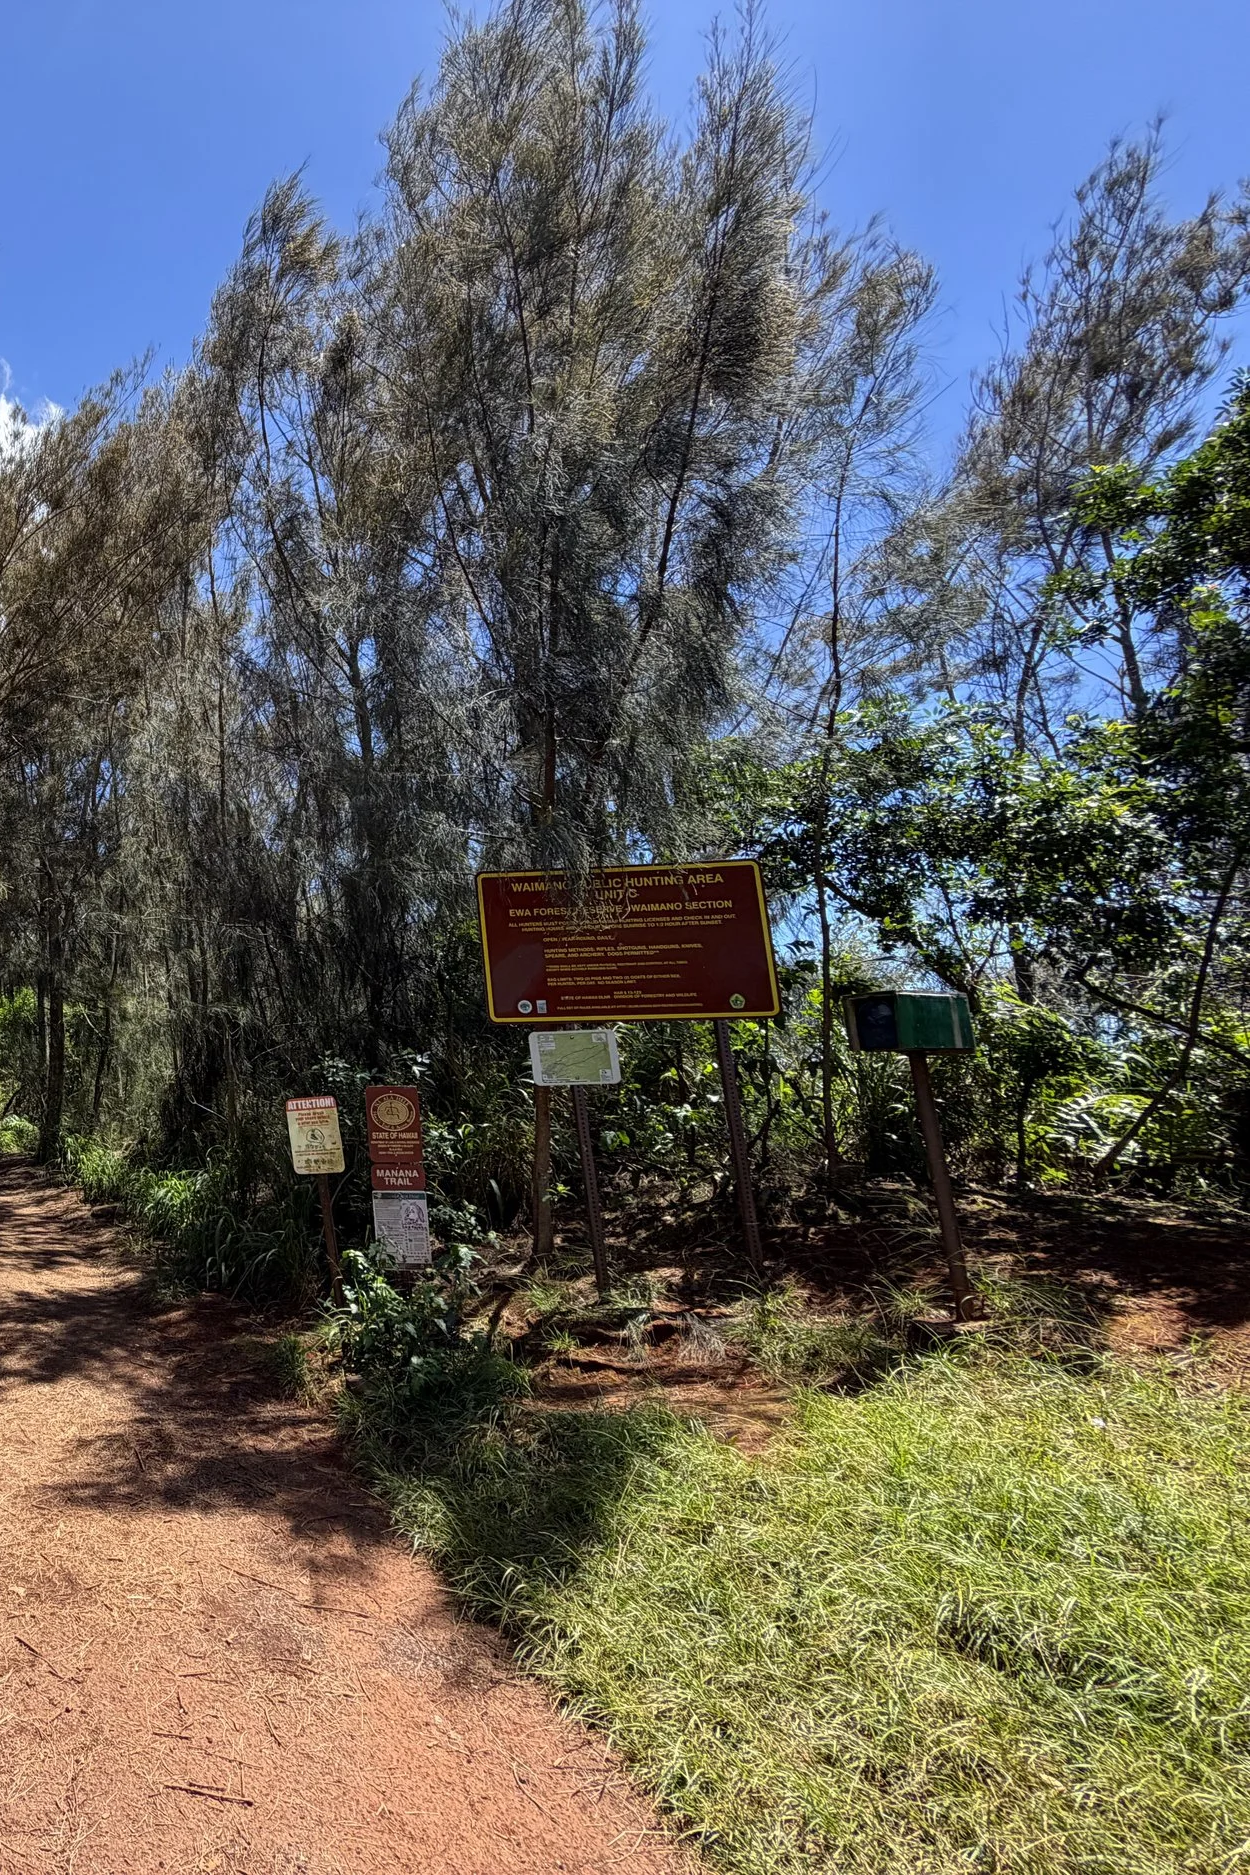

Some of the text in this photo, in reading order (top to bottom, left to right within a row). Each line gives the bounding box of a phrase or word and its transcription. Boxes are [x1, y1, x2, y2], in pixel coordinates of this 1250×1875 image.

[626, 875, 684, 887] HUNTING
[687, 873, 724, 885] AREA
[595, 889, 624, 900] UNIT
[509, 908, 531, 917] EWA
[631, 902, 682, 912] WAIMANO
[685, 900, 733, 910] SECTION
[288, 1097, 335, 1110] ATTENTION!
[384, 1177, 413, 1186] TRAIL
